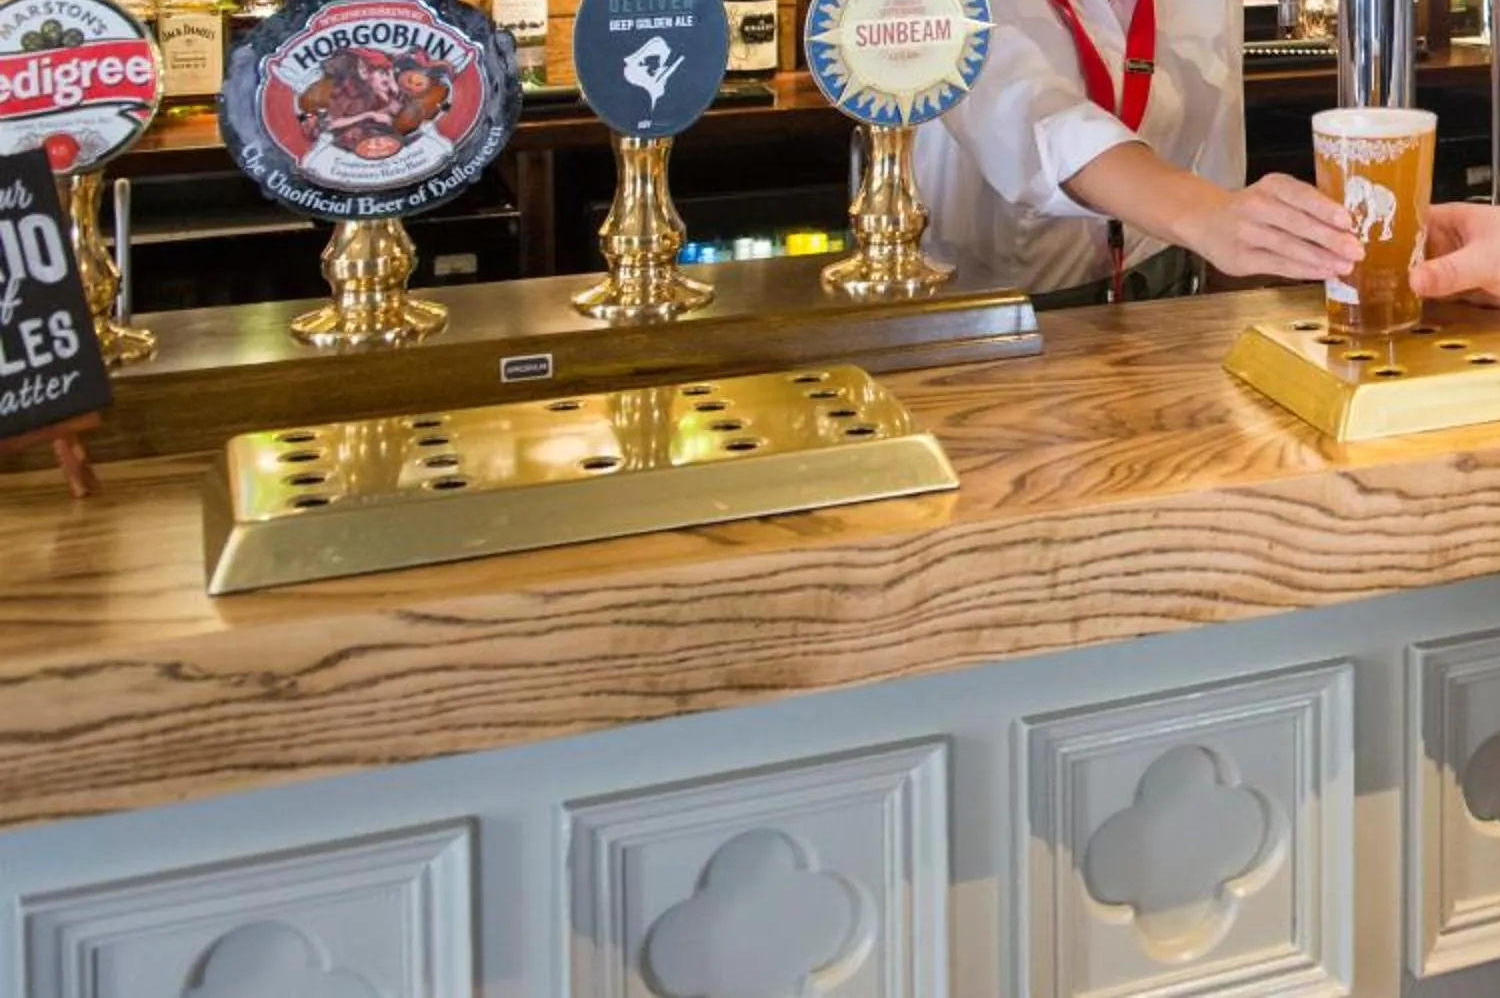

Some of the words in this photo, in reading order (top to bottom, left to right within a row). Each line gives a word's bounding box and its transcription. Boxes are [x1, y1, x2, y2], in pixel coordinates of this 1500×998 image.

[0, 1, 108, 41] MARSTON'S
[609, 19, 634, 32] DEEP
[636, 16, 673, 30] GOLDEN
[675, 15, 694, 28] ALE
[856, 19, 952, 47] SUNBEAM
[294, 23, 454, 69] HOBGOBLIN
[241, 144, 266, 177] The
[266, 170, 352, 215] Unofficial
[356, 193, 404, 215] Beer
[409, 185, 429, 205] of
[428, 126, 504, 199] Halloween
[0, 213, 68, 285] IO
[0, 274, 24, 325] f
